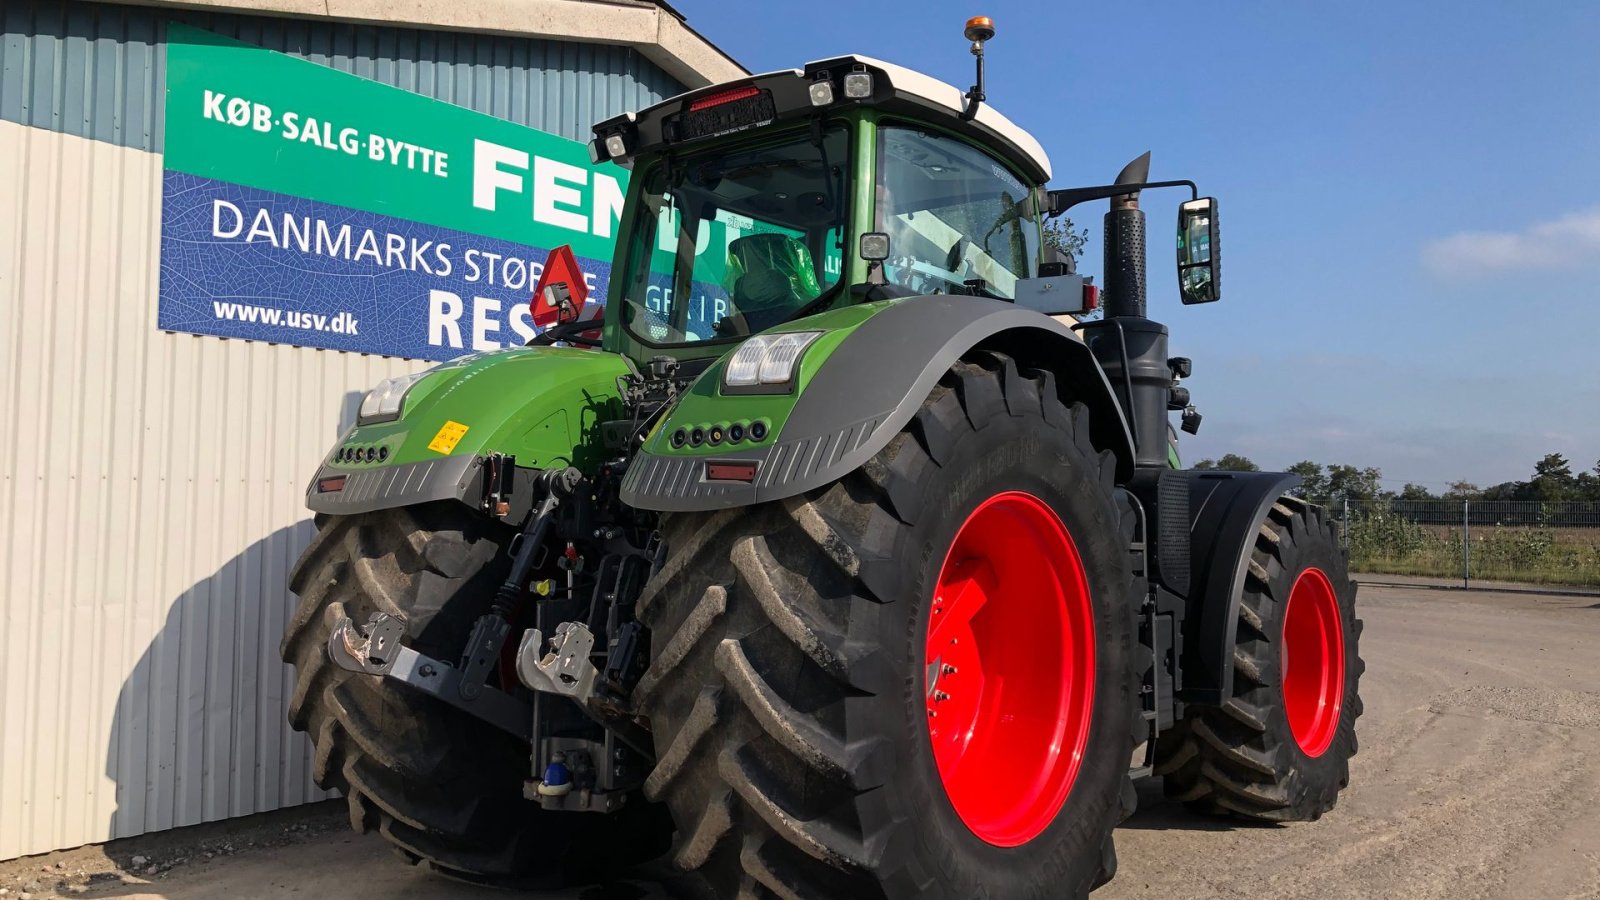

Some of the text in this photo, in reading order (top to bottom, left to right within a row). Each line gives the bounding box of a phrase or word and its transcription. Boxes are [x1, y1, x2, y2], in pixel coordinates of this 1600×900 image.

[212, 199, 452, 277] DANMARKS
[464, 249, 597, 304] STØRE
[213, 301, 359, 336] www.usv.dk
[428, 289, 539, 351] RES
